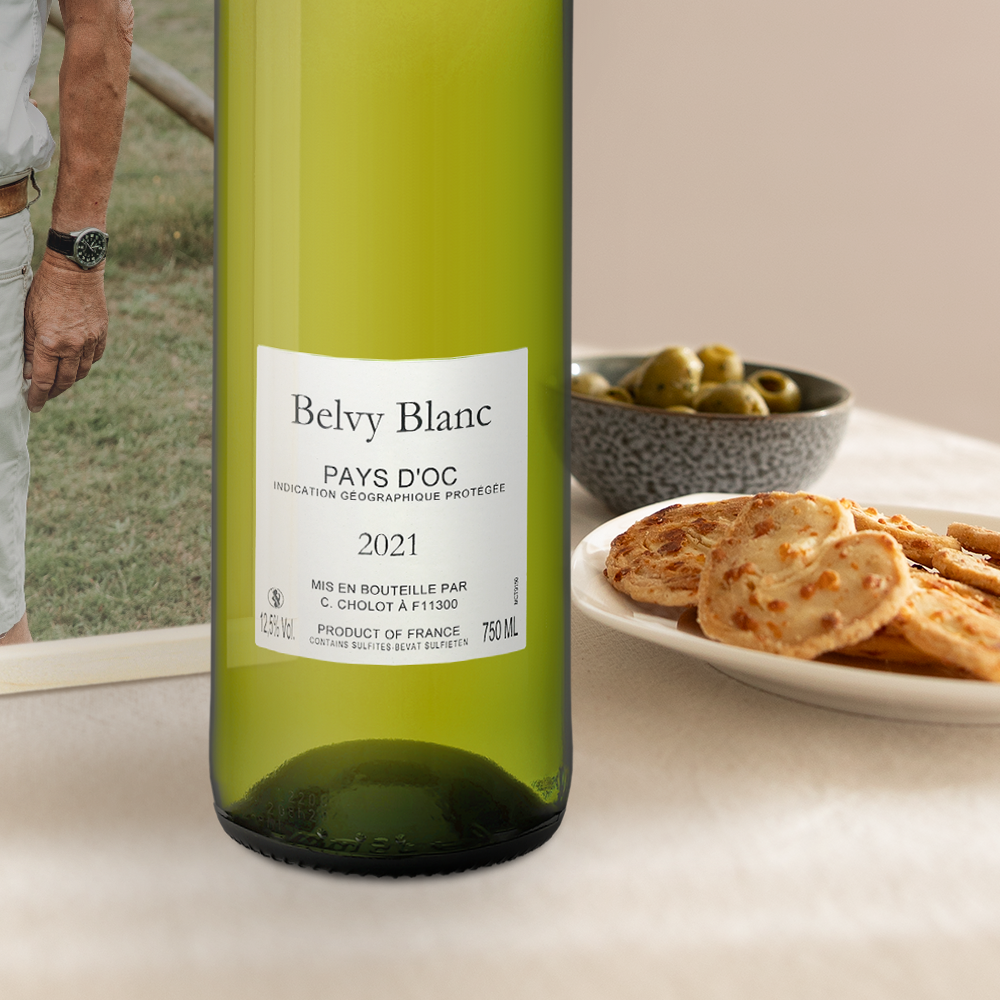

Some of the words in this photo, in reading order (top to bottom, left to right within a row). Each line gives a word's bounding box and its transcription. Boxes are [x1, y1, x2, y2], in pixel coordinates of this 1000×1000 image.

[290, 392, 386, 444] Belvy
[395, 399, 493, 434] Blanc
[323, 464, 389, 488] PAYS
[398, 465, 458, 489] D'OC
[272, 480, 337, 500] INDICATION
[339, 489, 441, 503] GÉOGRAPHIQUE
[443, 482, 507, 501] PROTÉGÉE
[357, 531, 419, 557] 2021
[310, 578, 335, 593] MIS
[337, 582, 357, 595] EN
[360, 583, 437, 597] BOUTEILLE
[440, 580, 469, 593] PAR
[319, 596, 333, 609] C.
[336, 598, 394, 613] CHOLOT
[397, 598, 409, 613] À
[411, 598, 460, 612] F11300
[316, 623, 381, 640] PRODUCT
[384, 628, 403, 641] OF
[406, 625, 462, 639] FRANCE
[482, 619, 502, 643] 750
[504, 615, 519, 639] ML
[308, 635, 350, 649] CONTAINS
[424, 637, 470, 650] SULFIETEN
